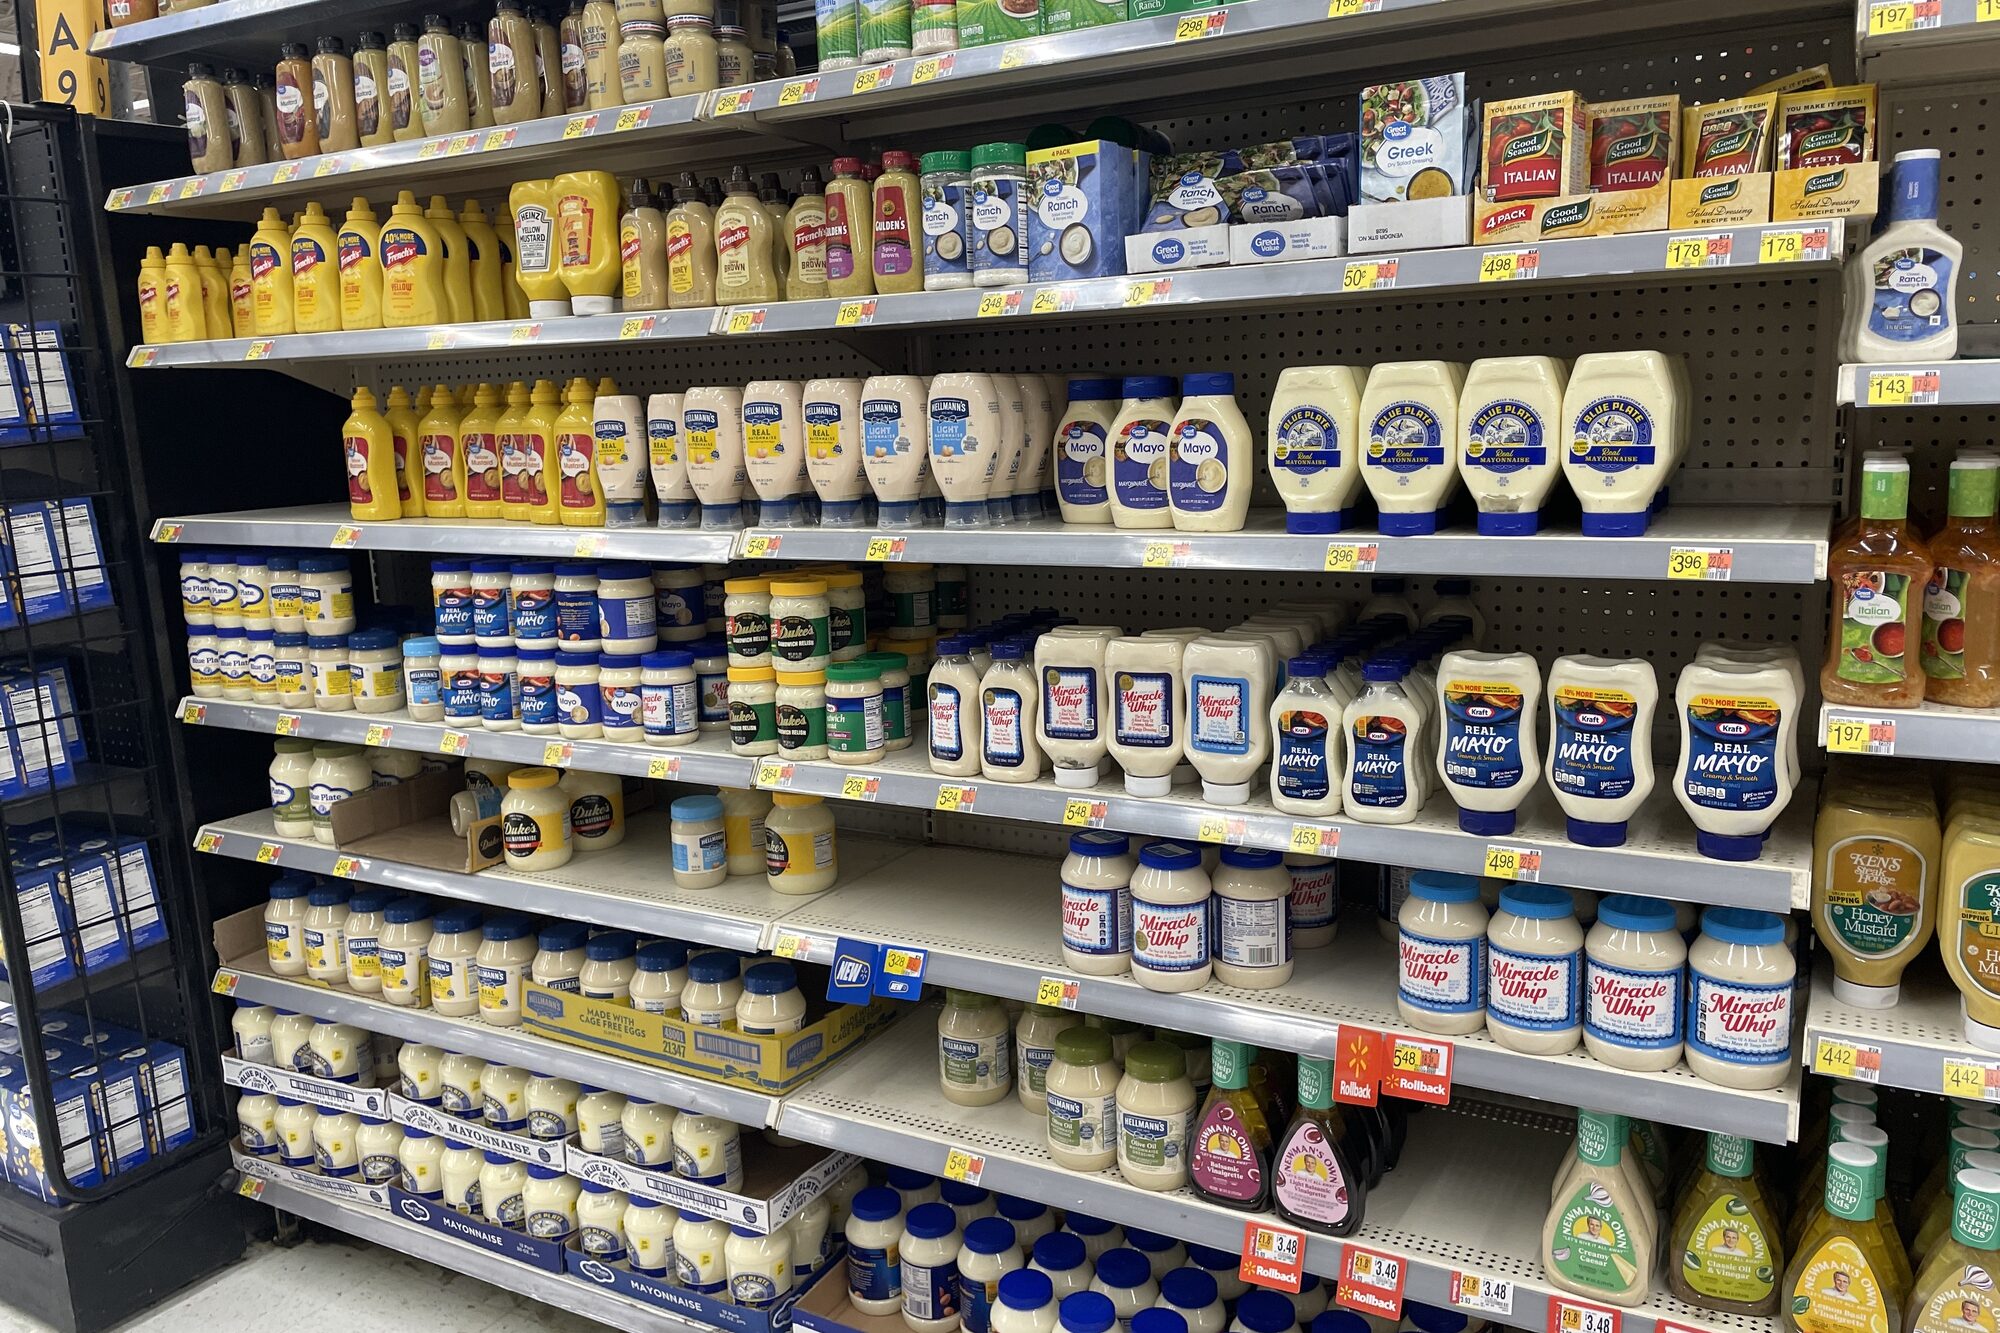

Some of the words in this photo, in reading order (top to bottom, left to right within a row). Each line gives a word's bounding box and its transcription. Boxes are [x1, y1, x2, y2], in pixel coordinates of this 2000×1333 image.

[49, 12, 79, 56] A
[58, 69, 77, 106] 9
[1386, 125, 1407, 134] Great
[1512, 138, 1536, 149] Good
[1616, 138, 1642, 150] Good
[1709, 142, 1740, 155] Seasons
[1716, 136, 1738, 149] Good
[1387, 142, 1433, 159] Greek
[1507, 143, 1541, 157] Seasons
[1611, 145, 1647, 158] Seasons
[1803, 154, 1842, 165] ZESTY
[1504, 169, 1556, 184] ITALIAN
[1812, 174, 1834, 185] Good
[1708, 184, 1729, 194] Good
[1807, 180, 1839, 191] Seasons
[1180, 189, 1214, 199] Ranch
[1703, 189, 1733, 200] Seasons
[976, 205, 1001, 216] Ranch
[1048, 200, 1078, 212] Ranch
[1253, 203, 1290, 215] Ranch
[1790, 198, 1821, 211] Salad
[1821, 197, 1860, 208] Dressing
[520, 211, 540, 222] HEINZ
[925, 212, 948, 222] Ranch
[1551, 206, 1577, 218] Good
[1805, 208, 1835, 216] RECIPE
[1545, 212, 1583, 227] Seasons
[522, 226, 540, 234] YELLOW
[385, 234, 399, 243] 40%
[400, 232, 415, 242] MORE
[720, 227, 748, 249] French's
[1255, 237, 1280, 246] Great
[668, 237, 690, 255] French's
[1156, 246, 1179, 254] Great
[340, 250, 361, 269] French's
[387, 248, 417, 264] French's
[294, 254, 316, 273] French's
[1899, 275, 1927, 283] Ranch
[863, 404, 898, 414] HELLMANN'S
[931, 402, 965, 412] HELLMANN'S
[1584, 402, 1609, 424] BLUE
[1612, 401, 1643, 423] PLATE
[1378, 408, 1401, 428] BLUE
[1404, 406, 1433, 427] PLATE
[1478, 405, 1502, 426] BLUE
[1505, 404, 1534, 426] PLATE
[869, 427, 891, 435] LIGHT
[936, 426, 958, 434] LIGHT
[1070, 443, 1097, 454] Mayo
[1133, 443, 1165, 454] Mayo
[1183, 443, 1211, 454] Mayo
[662, 601, 681, 609] Mayo
[1858, 607, 1890, 616] Italian
[439, 612, 471, 623] MAYO
[517, 615, 547, 626] MAYO
[1051, 684, 1088, 697] Miracle
[1122, 690, 1164, 701] Miracle
[451, 692, 481, 704] MAYO
[616, 700, 638, 708] Mayo
[1055, 696, 1082, 707] Whip
[1199, 695, 1240, 707] Miracle
[521, 701, 547, 711] MAYO
[1127, 701, 1157, 714] Whip
[1471, 708, 1489, 716] Kraft
[1204, 706, 1233, 720] Whip
[1581, 715, 1600, 724] Kraft
[1465, 725, 1496, 735] REAL
[1722, 724, 1742, 733] Kraft
[1574, 731, 1608, 743] REAL
[1291, 747, 1312, 755] REAL
[1450, 736, 1513, 753] MAYO
[1714, 742, 1751, 753] REAL
[1559, 743, 1625, 763] MAYO
[1280, 754, 1324, 768] MAYO
[1355, 761, 1402, 774] MAYO
[1693, 754, 1769, 774] MAYO
[503, 821, 537, 835] Duke's
[1850, 853, 1902, 872] KEN'S
[1827, 895, 1860, 904] DIPPING
[1140, 912, 1198, 930] Miracle
[1851, 907, 1893, 924] Honey
[1961, 912, 1990, 921] DIPPING
[1844, 921, 1898, 938] Mustard
[1146, 930, 1190, 950] Whip
[1400, 941, 1459, 964] Miracle
[837, 961, 862, 982] NEW
[1405, 961, 1448, 986] Whip
[1492, 958, 1559, 981] Miracle
[1499, 978, 1548, 1004] Whip
[1593, 975, 1667, 999] Miracle
[1602, 996, 1656, 1022] Whip
[1708, 993, 1786, 1014] Miracle
[586, 1008, 611, 1019] MADE
[612, 1013, 634, 1026] WITH
[579, 1014, 600, 1026] CAGE
[601, 1019, 620, 1030] FREE
[622, 1026, 646, 1038] EGGS
[1720, 1013, 1777, 1037] Whip
[1340, 1080, 1371, 1099] Rollback
[1400, 1078, 1446, 1096] Rollback
[1125, 1118, 1165, 1132] HELLMANN'S
[447, 1122, 532, 1156] MAYONNAISE
[1200, 1124, 1238, 1152] NEWMAN'S
[1237, 1136, 1251, 1161] OWN
[1967, 1197, 1993, 1213] 100%
[1562, 1206, 1611, 1236] NEWMAN'S
[1611, 1220, 1627, 1249] OWN
[1966, 1213, 1993, 1231] Help
[442, 1216, 503, 1246] MAYONNAISE
[1960, 1220, 1986, 1238] Kids
[1696, 1218, 1750, 1250] NEWMAN'S
[1750, 1231, 1764, 1260] OWN
[1578, 1247, 1609, 1261] Creamy
[1579, 1255, 1608, 1267] Caesar
[1256, 1265, 1297, 1284] Rollback
[1804, 1260, 1861, 1291] NEWMAN'S
[1861, 1275, 1877, 1308] OWN
[630, 1280, 703, 1313] MAYONNAISE
[1353, 1290, 1396, 1311] Rollback
